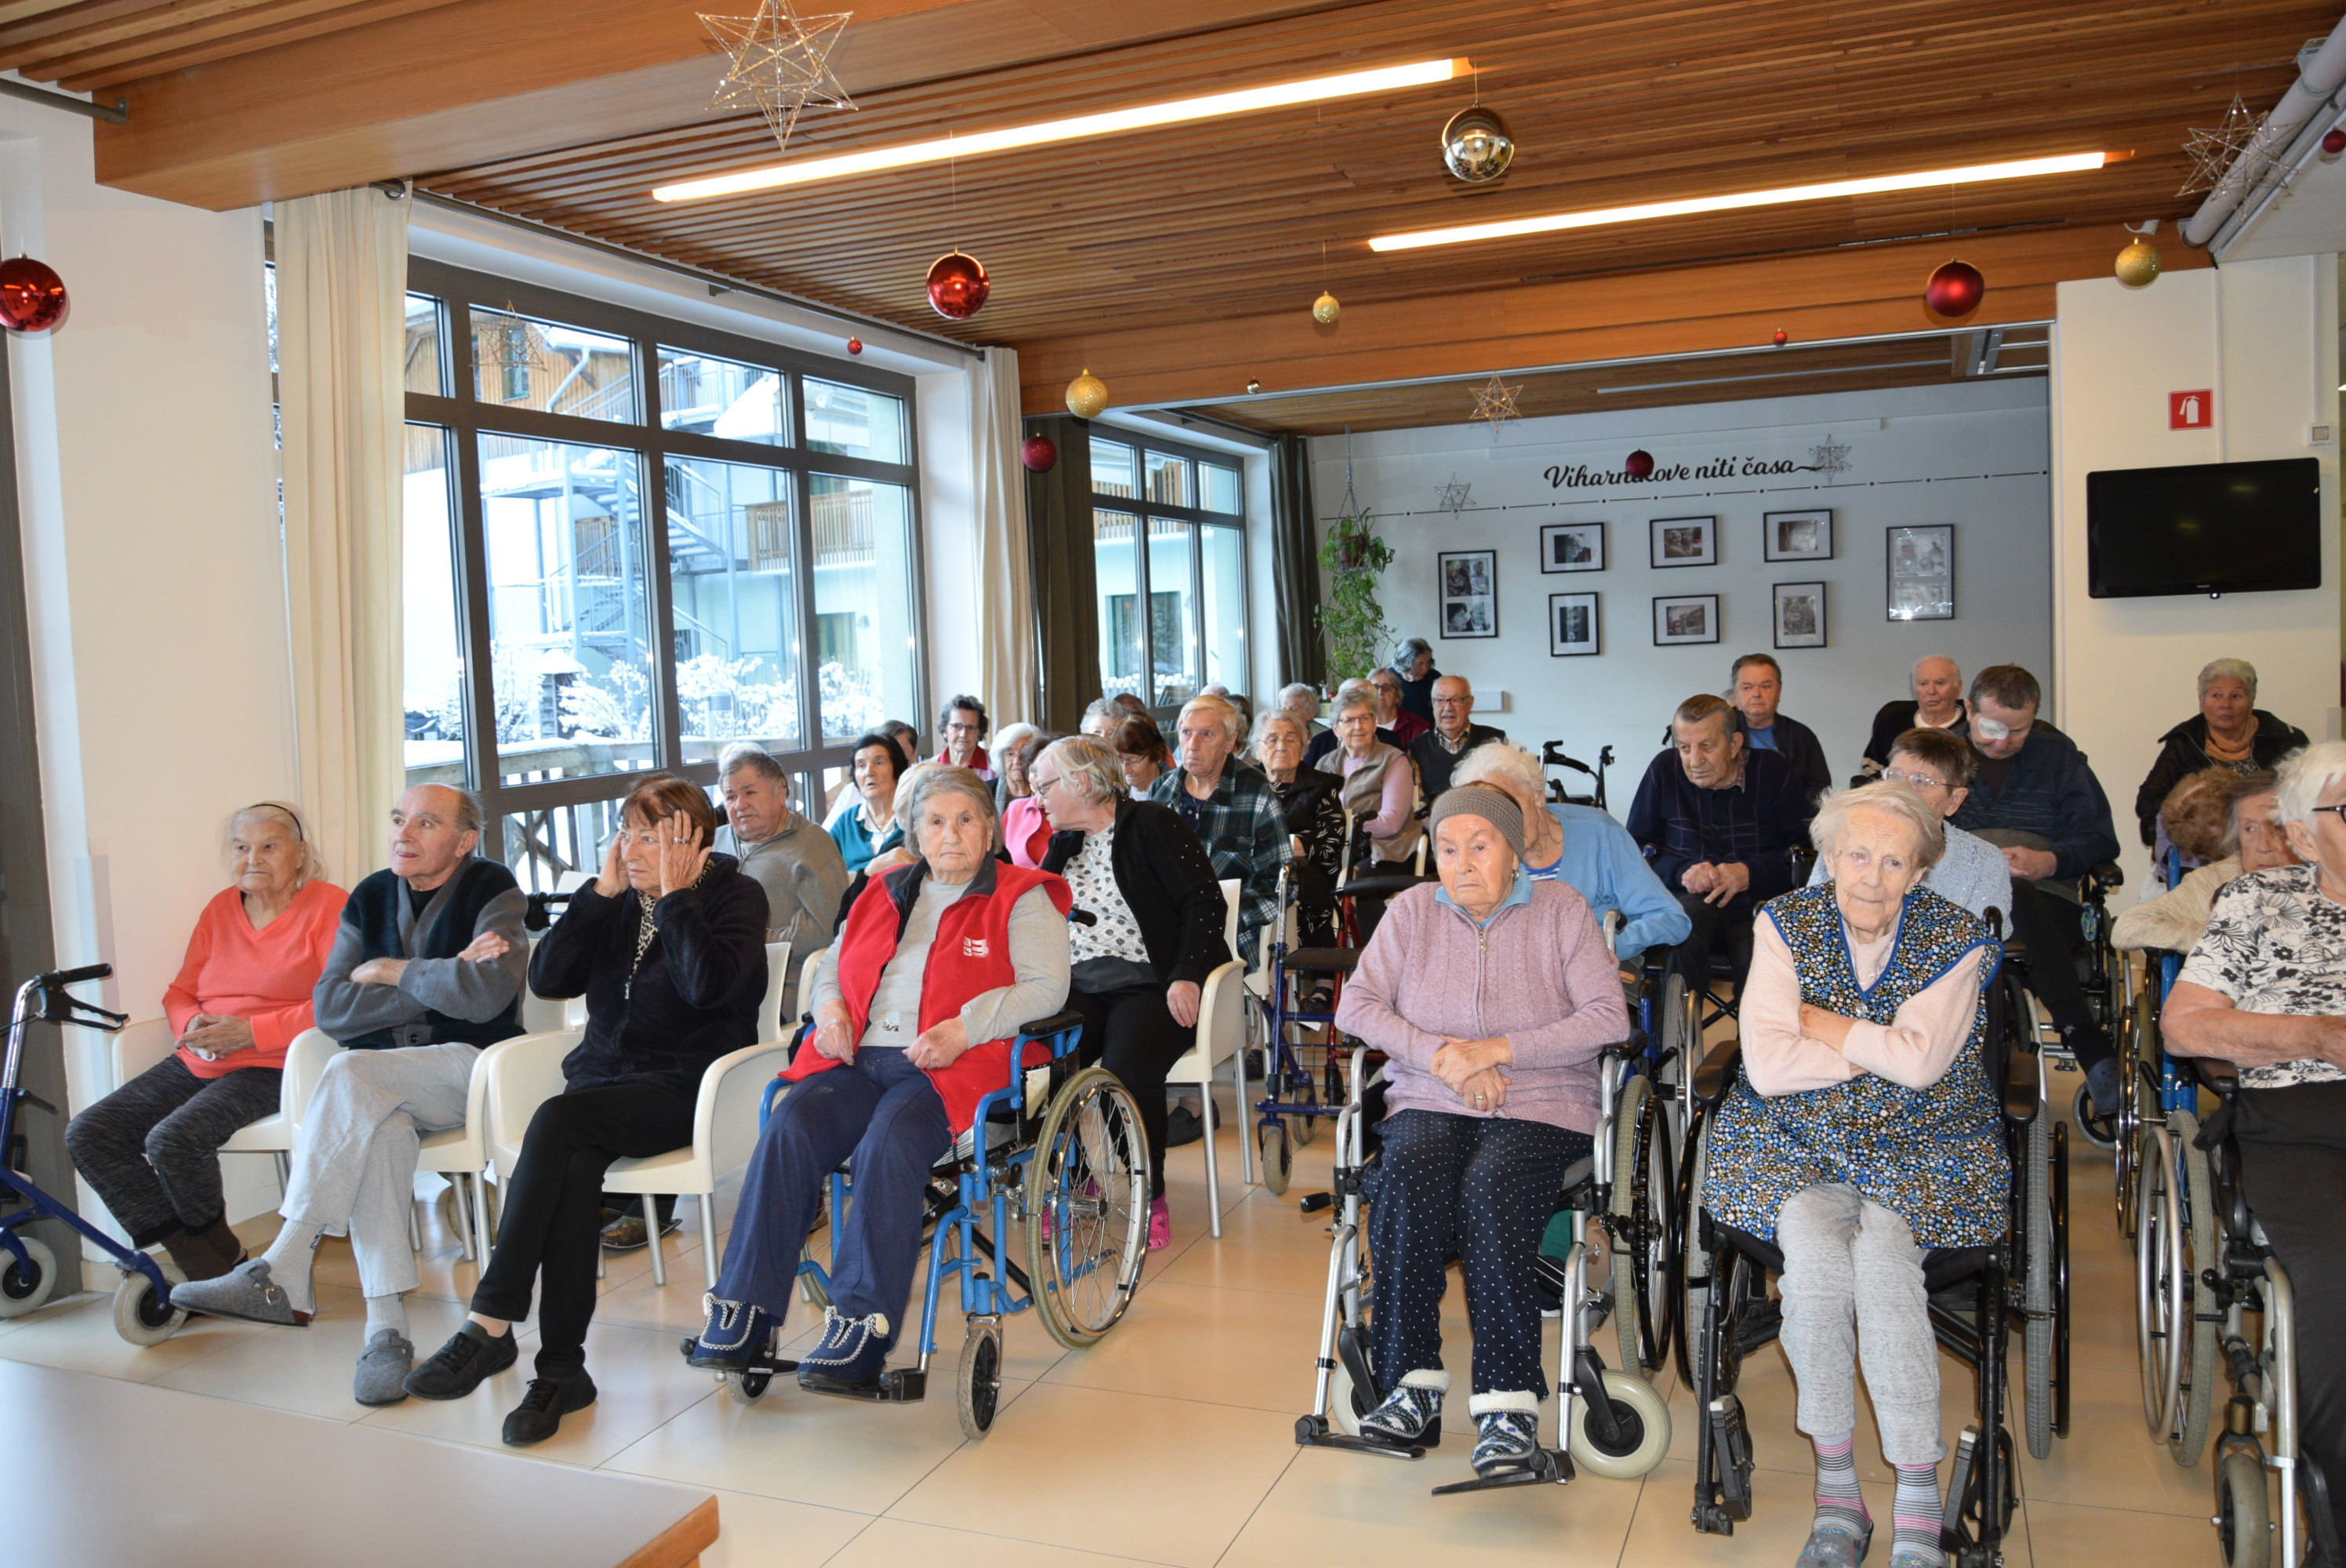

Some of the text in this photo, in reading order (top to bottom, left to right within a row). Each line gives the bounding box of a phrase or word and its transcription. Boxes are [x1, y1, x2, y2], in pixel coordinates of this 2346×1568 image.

[1543, 456, 1825, 488] Viharnove niti časa
